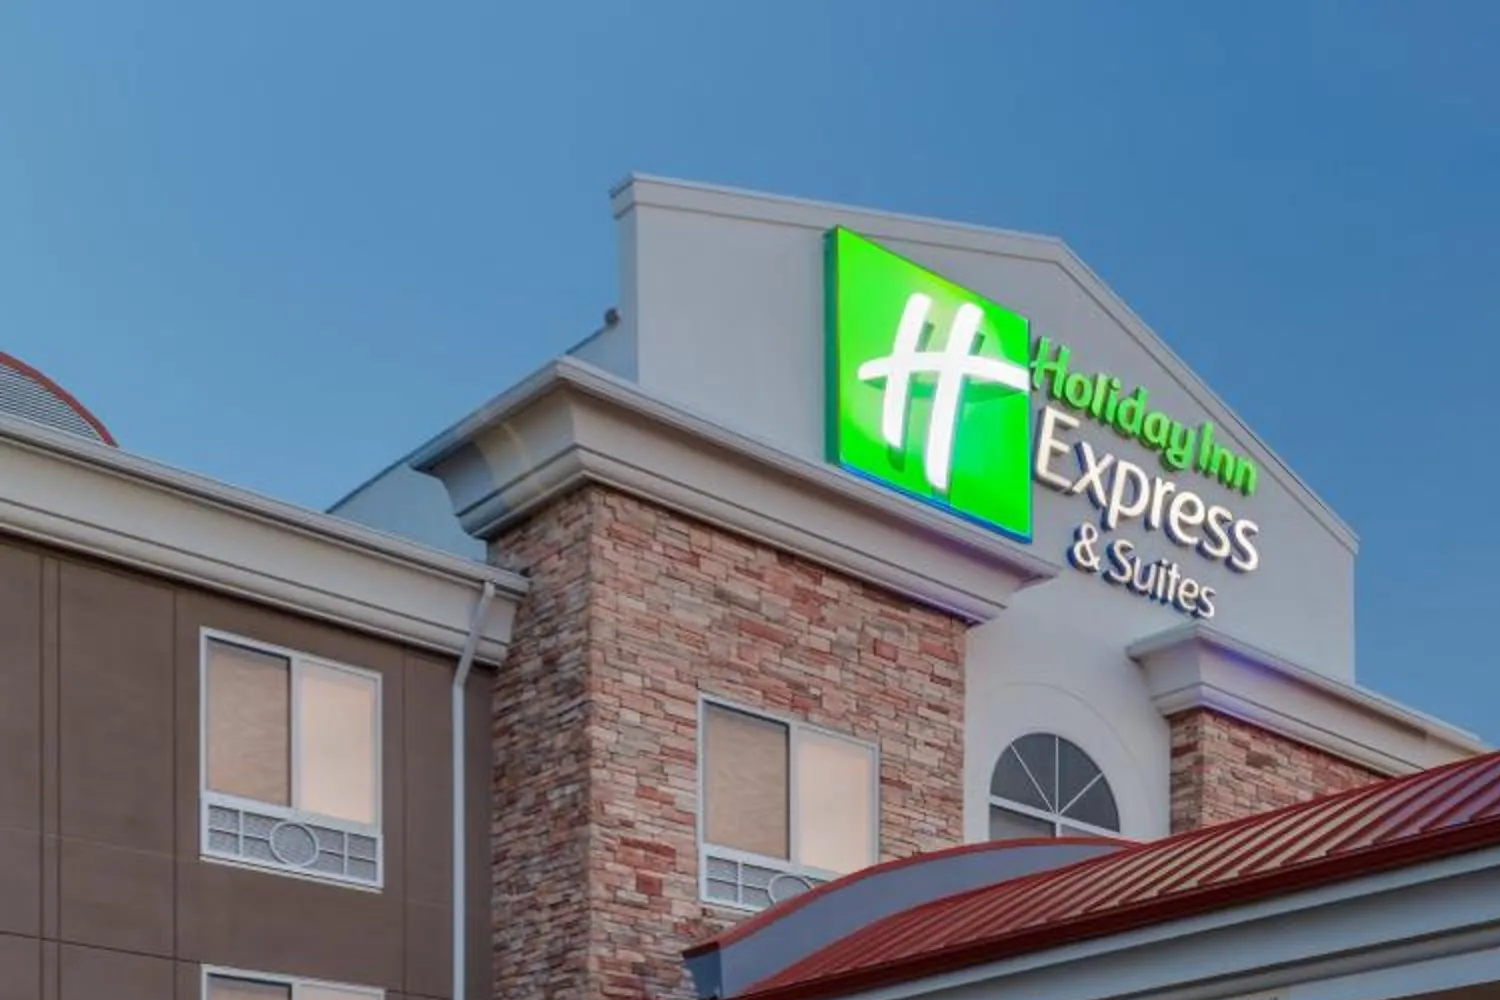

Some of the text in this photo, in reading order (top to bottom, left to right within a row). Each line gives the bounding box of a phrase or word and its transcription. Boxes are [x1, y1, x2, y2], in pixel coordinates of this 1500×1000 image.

[1030, 336, 1257, 498] Holiday Inn
[1035, 404, 1259, 573] Express
[1069, 522, 1216, 619] & Suites
